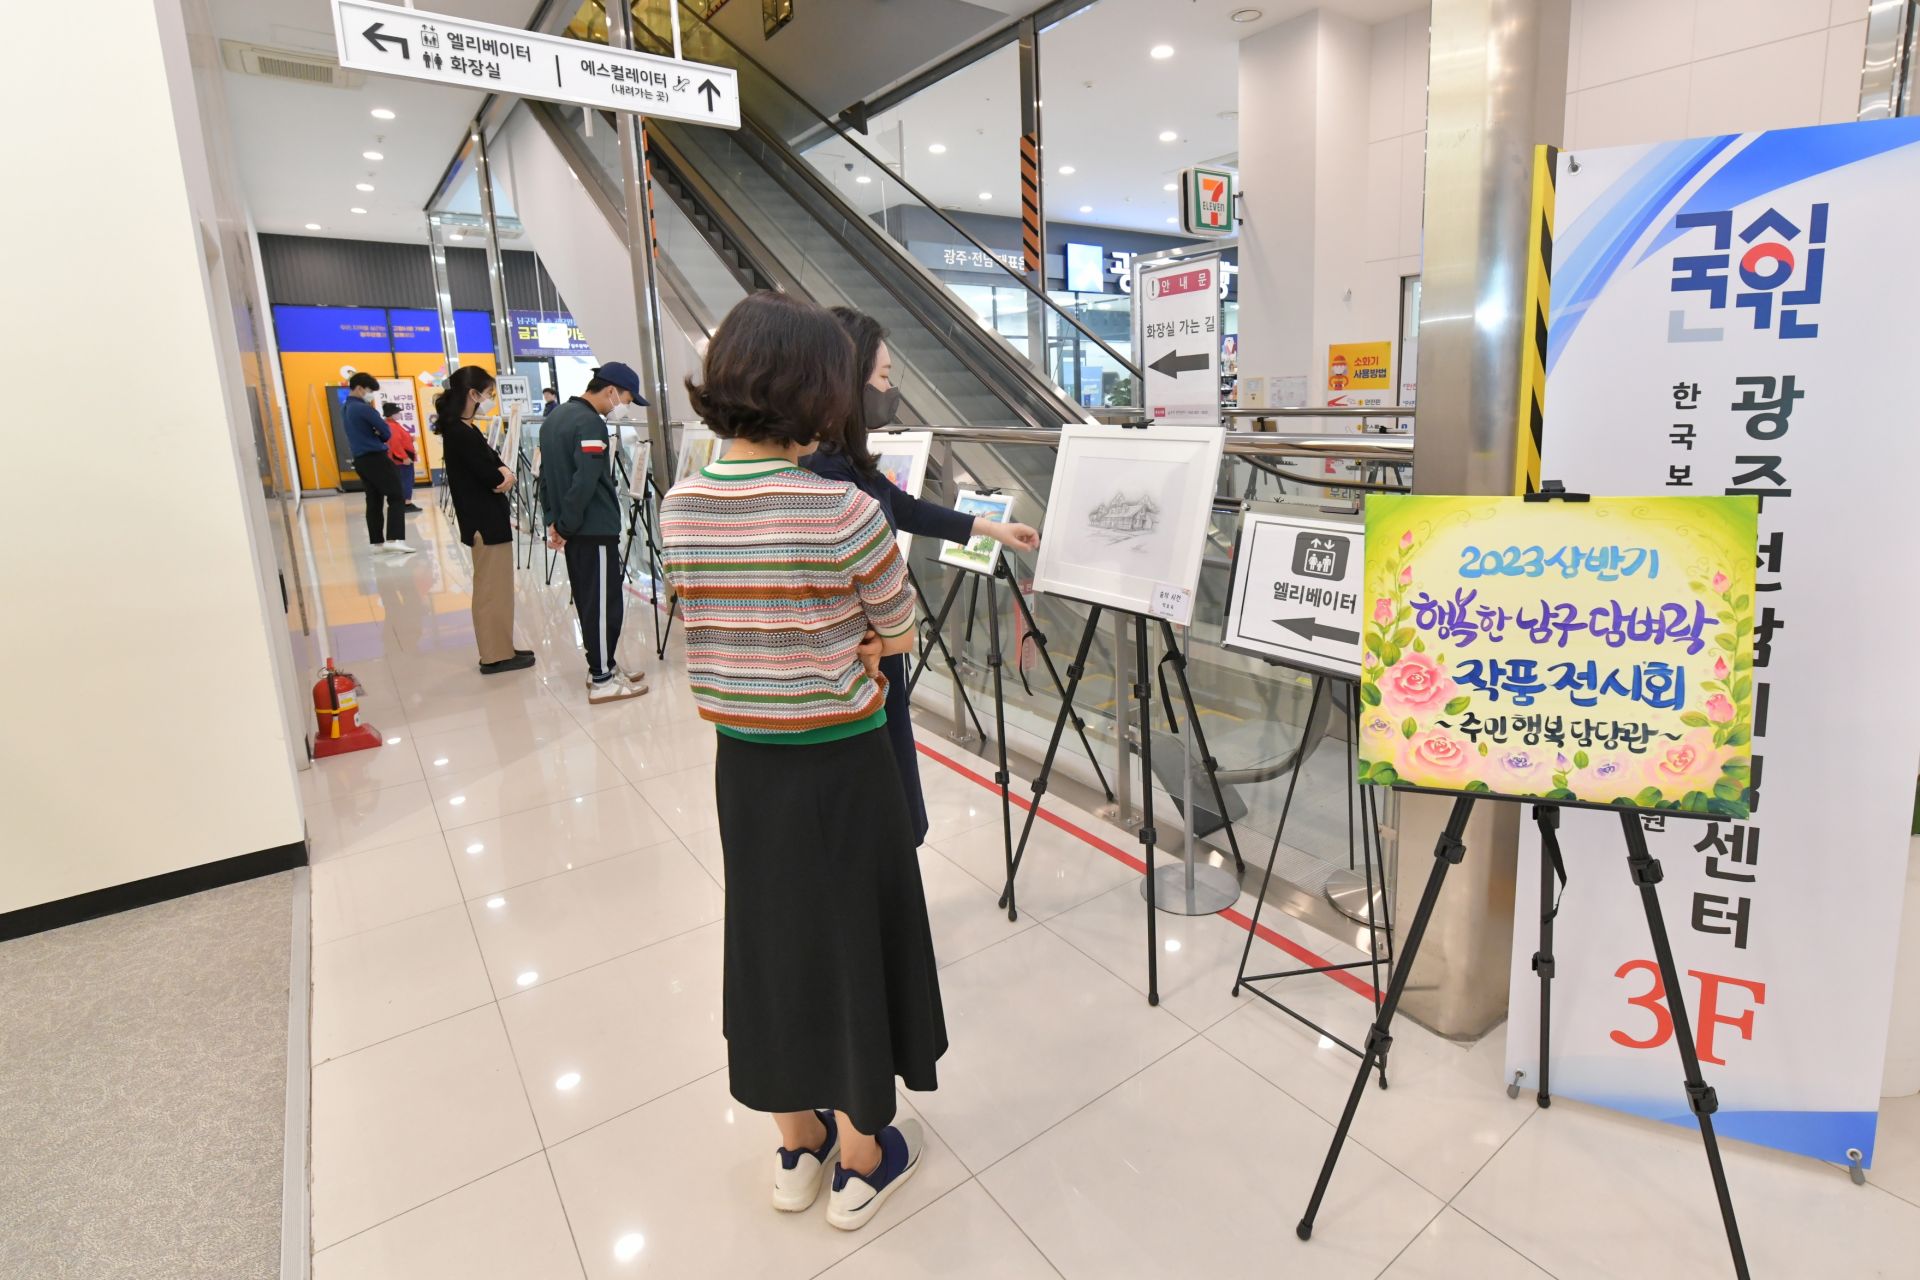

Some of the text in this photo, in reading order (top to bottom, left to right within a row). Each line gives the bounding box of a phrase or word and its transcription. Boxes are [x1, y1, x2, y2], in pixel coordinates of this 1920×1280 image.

[447, 32, 531, 62] 엘리베이터
[450, 55, 501, 80] 화장실
[580, 59, 667, 89] 에스컬레이터
[611, 83, 669, 103] (내려가는 곳)
[1203, 178, 1223, 226] 7
[1146, 315, 1215, 339] 화장실 가는 길
[1354, 357, 1379, 366] 소화기
[1354, 368, 1387, 378] 사용방법
[1273, 581, 1357, 614] 엘리베이터
[1409, 586, 1720, 655] 행복한 남구 담벼락
[1452, 658, 1686, 711] 작품 전시회
[1609, 959, 1766, 1066] 3F
